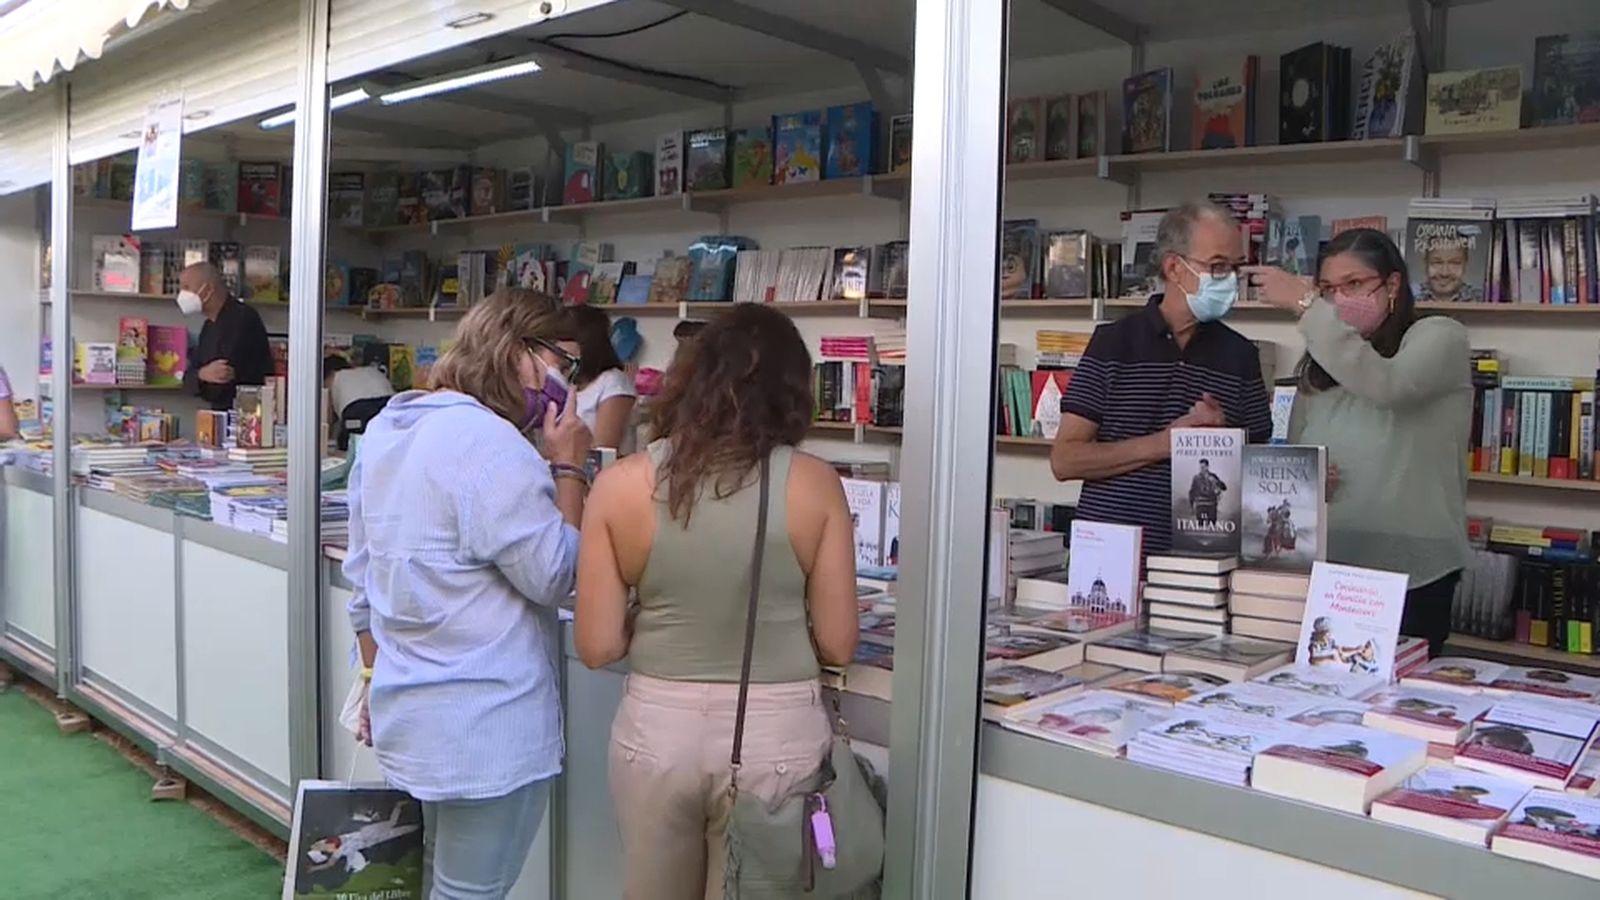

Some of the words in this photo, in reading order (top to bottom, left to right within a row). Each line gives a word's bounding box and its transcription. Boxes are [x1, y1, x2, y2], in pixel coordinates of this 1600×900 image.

[1352, 56, 1376, 141] CIENCIA
[1176, 434, 1235, 448] ARTURO
[1260, 466, 1309, 481] REINA
[1258, 482, 1298, 495] SOLA
[1176, 518, 1236, 533] ITALIANO
[1335, 593, 1367, 605] familia
